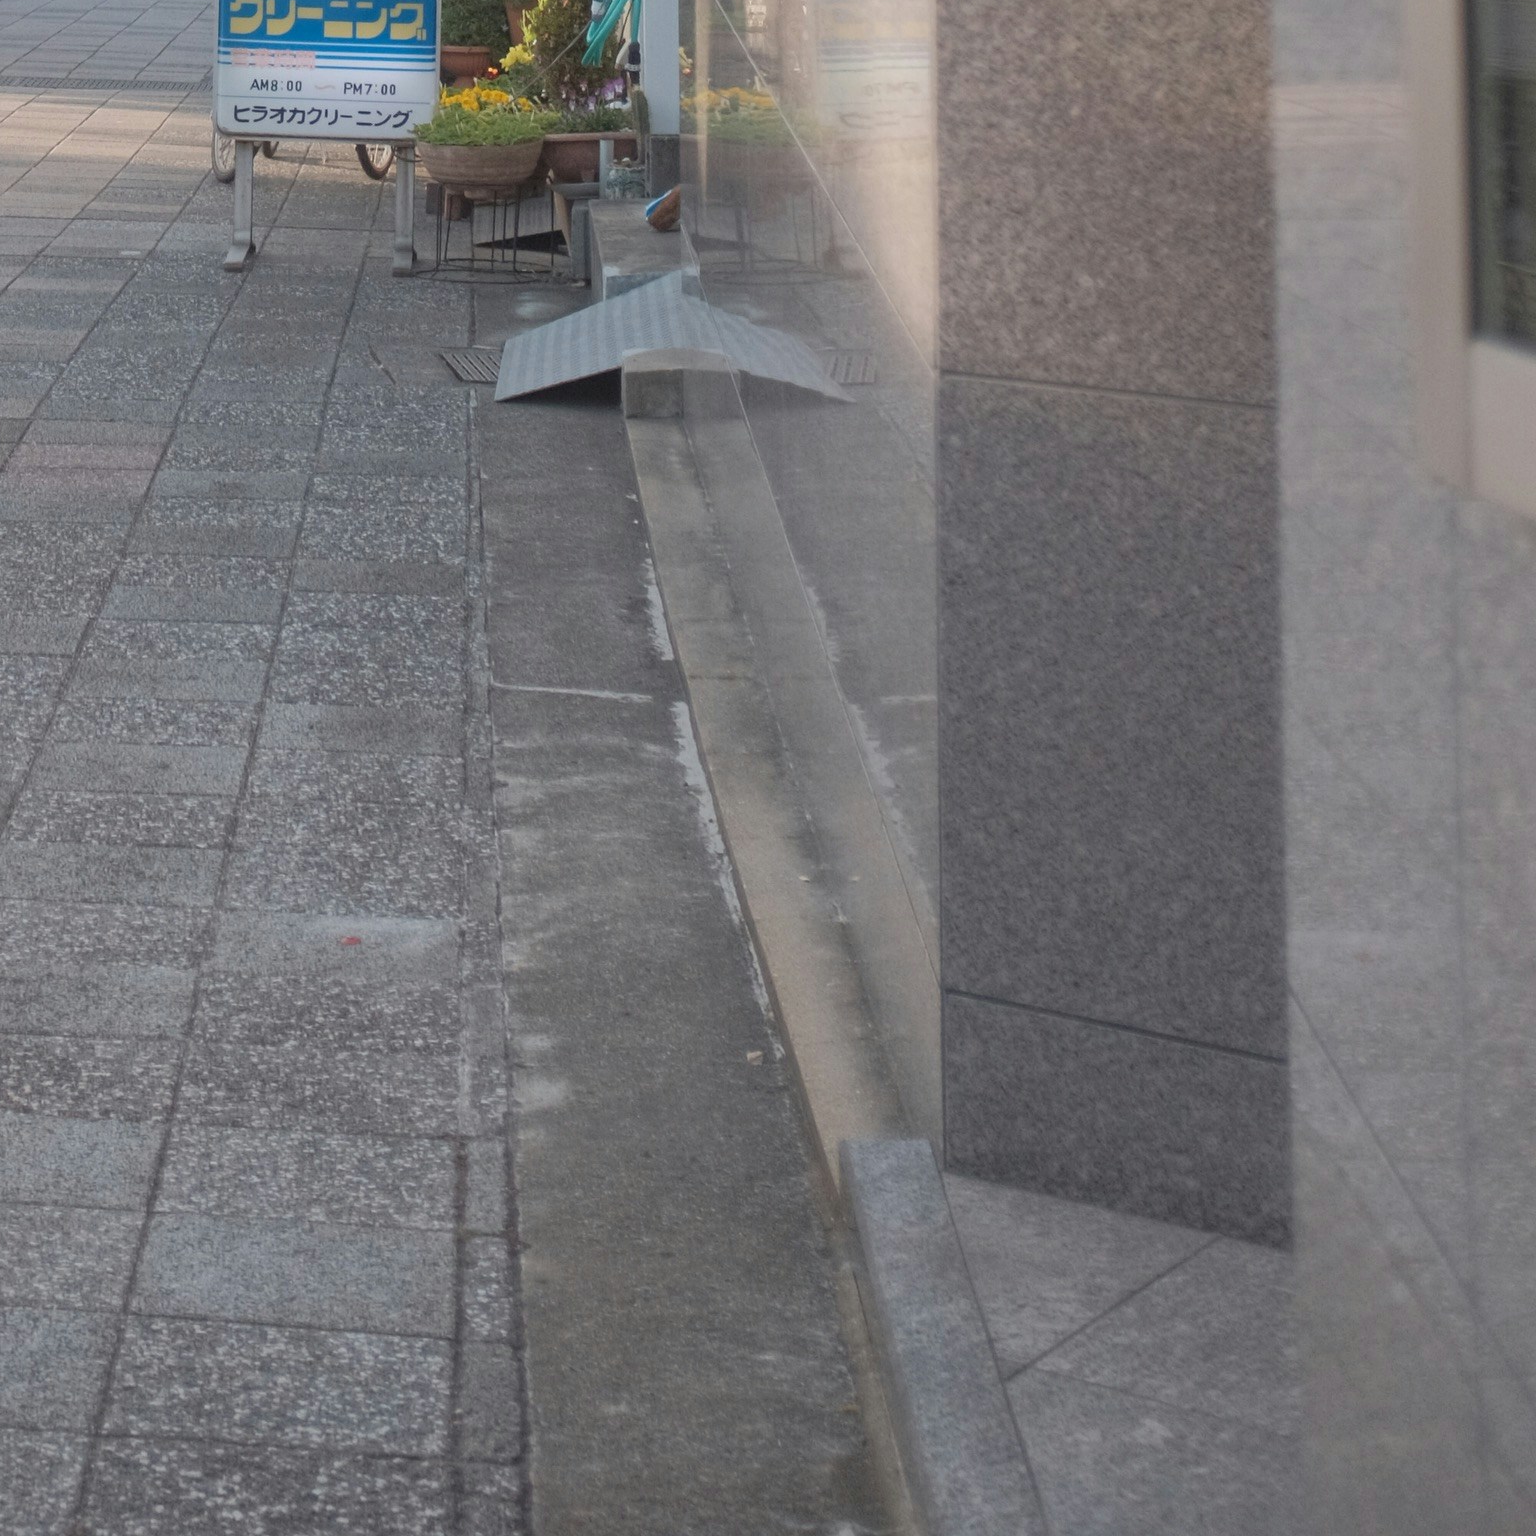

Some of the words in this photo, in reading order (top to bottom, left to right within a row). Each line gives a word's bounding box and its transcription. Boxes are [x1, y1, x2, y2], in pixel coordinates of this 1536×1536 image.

[250, 79, 302, 91] AM8:00
[344, 82, 396, 95] PM7:00
[234, 105, 413, 128] ヒラオカクリーニング
